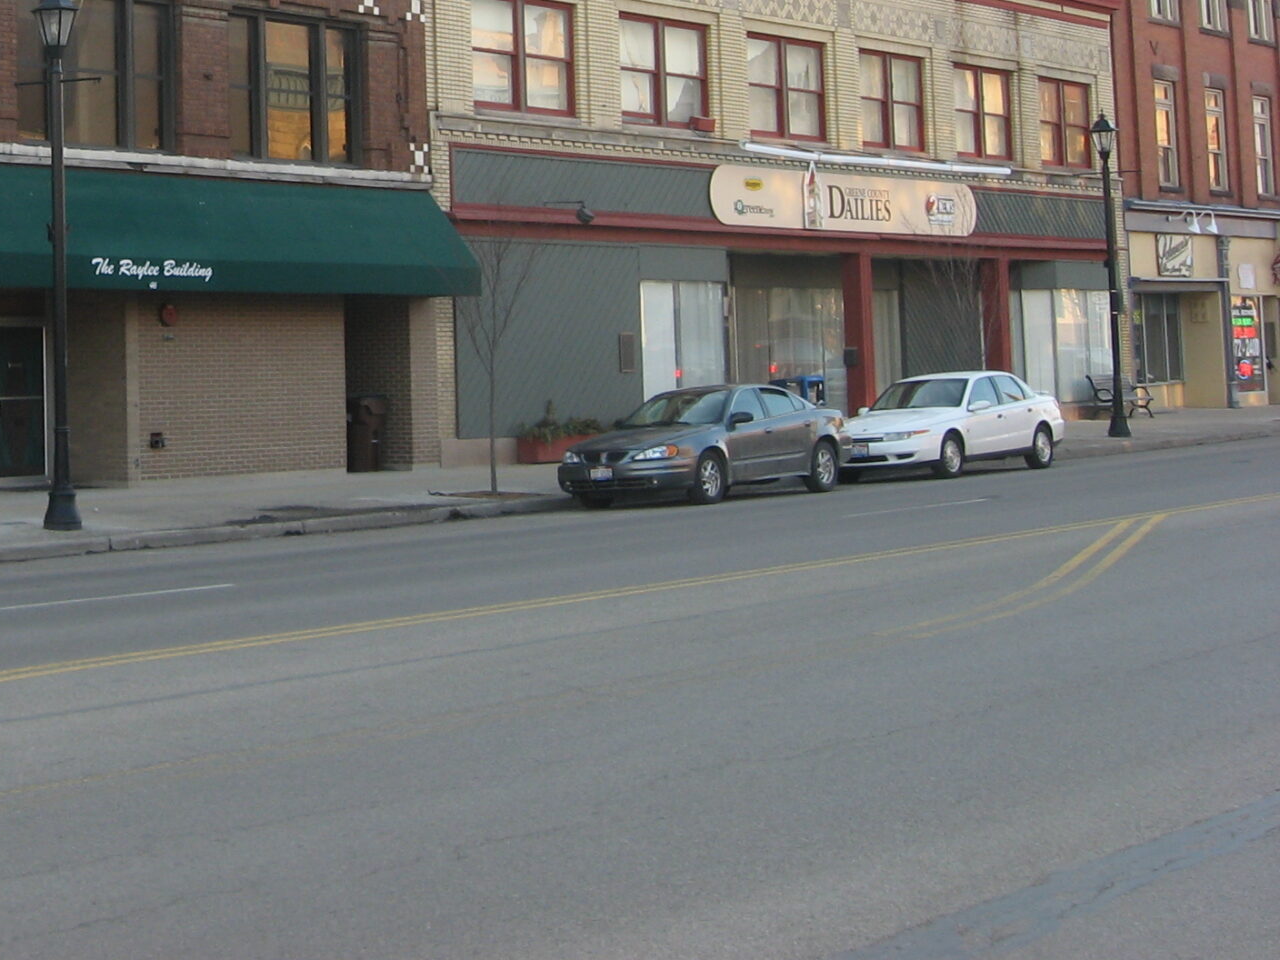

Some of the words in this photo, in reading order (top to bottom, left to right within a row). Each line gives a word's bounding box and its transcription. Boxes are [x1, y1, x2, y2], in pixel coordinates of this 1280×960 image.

[827, 185, 892, 222] DAILIES
[845, 187, 866, 197] GREENE
[867, 189, 890, 199] COUNTY
[91, 257, 114, 276] The
[118, 259, 160, 280] Raylee
[163, 259, 213, 282] Building
